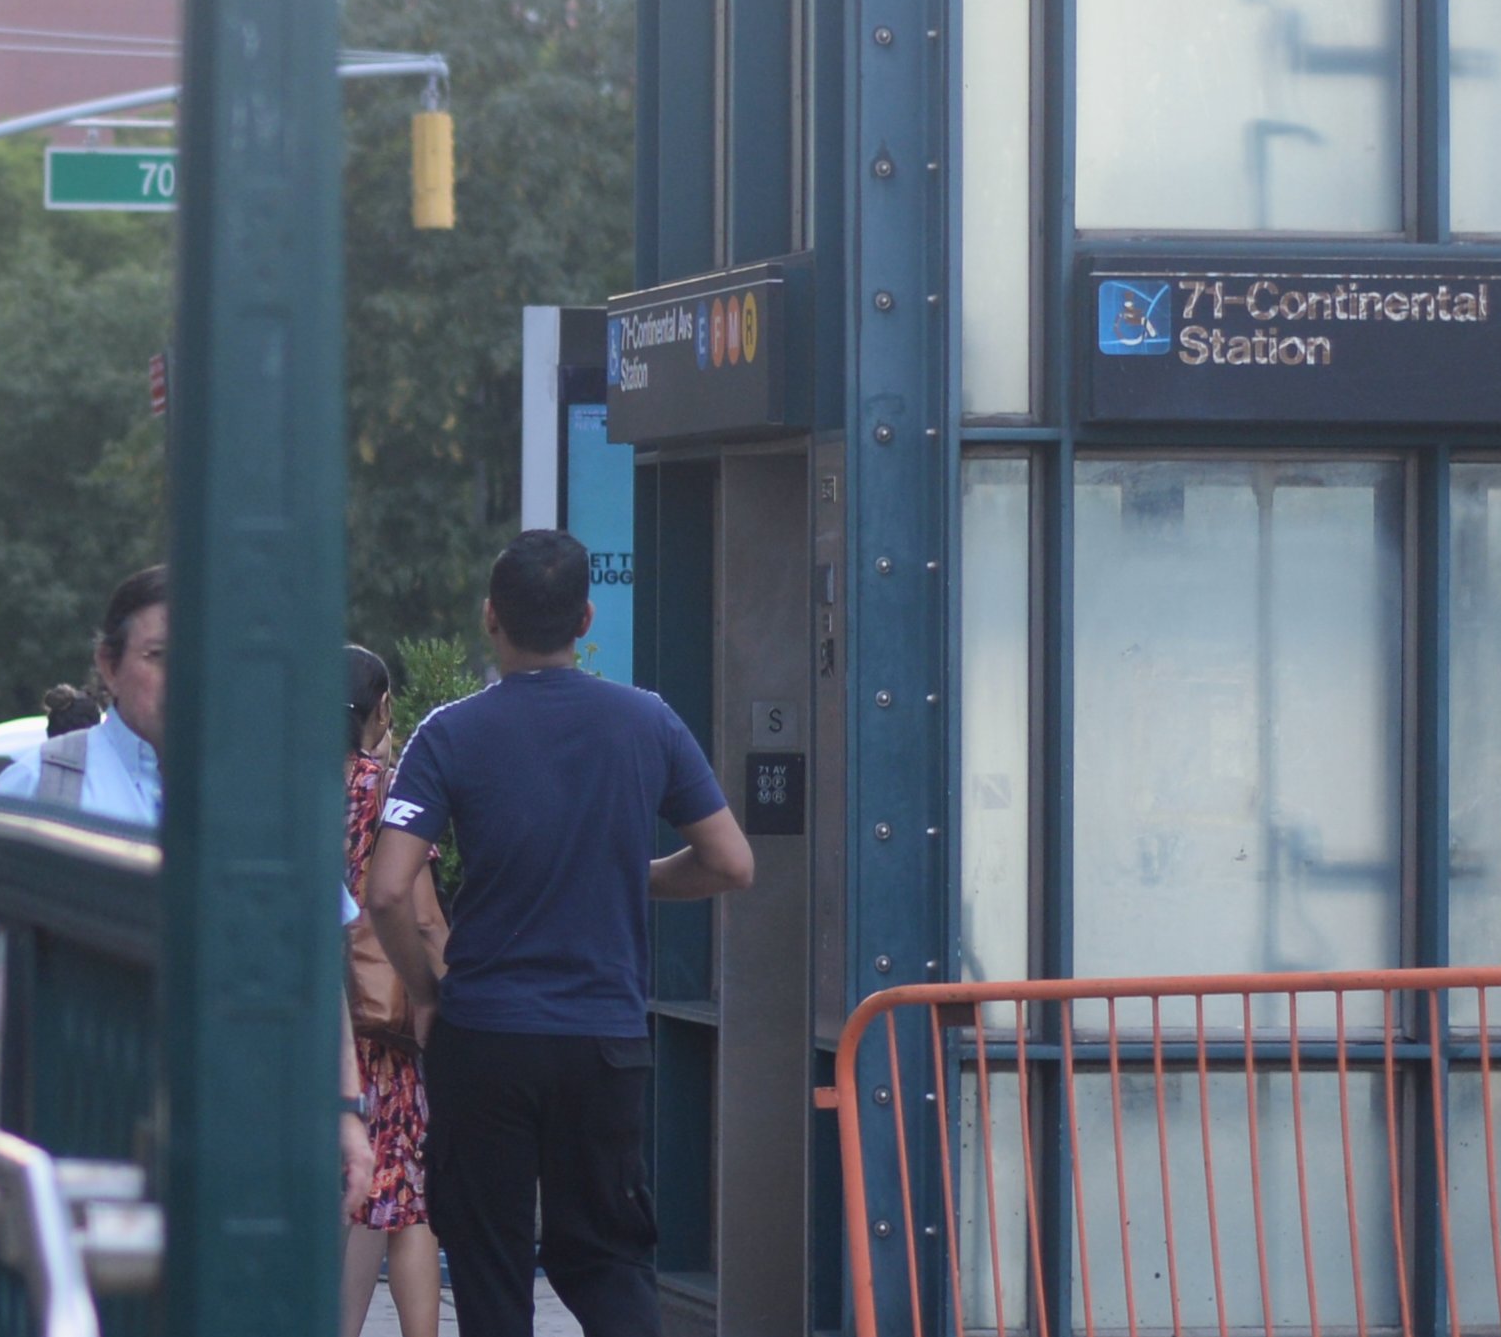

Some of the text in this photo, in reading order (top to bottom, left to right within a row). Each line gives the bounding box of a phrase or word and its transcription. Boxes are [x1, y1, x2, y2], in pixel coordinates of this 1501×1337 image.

[139, 163, 175, 196] 70
[1178, 280, 1488, 322] 71-Continental
[1178, 324, 1332, 365] Station
[621, 355, 648, 393] Station
[590, 553, 615, 568] ET
[768, 708, 783, 733] S
